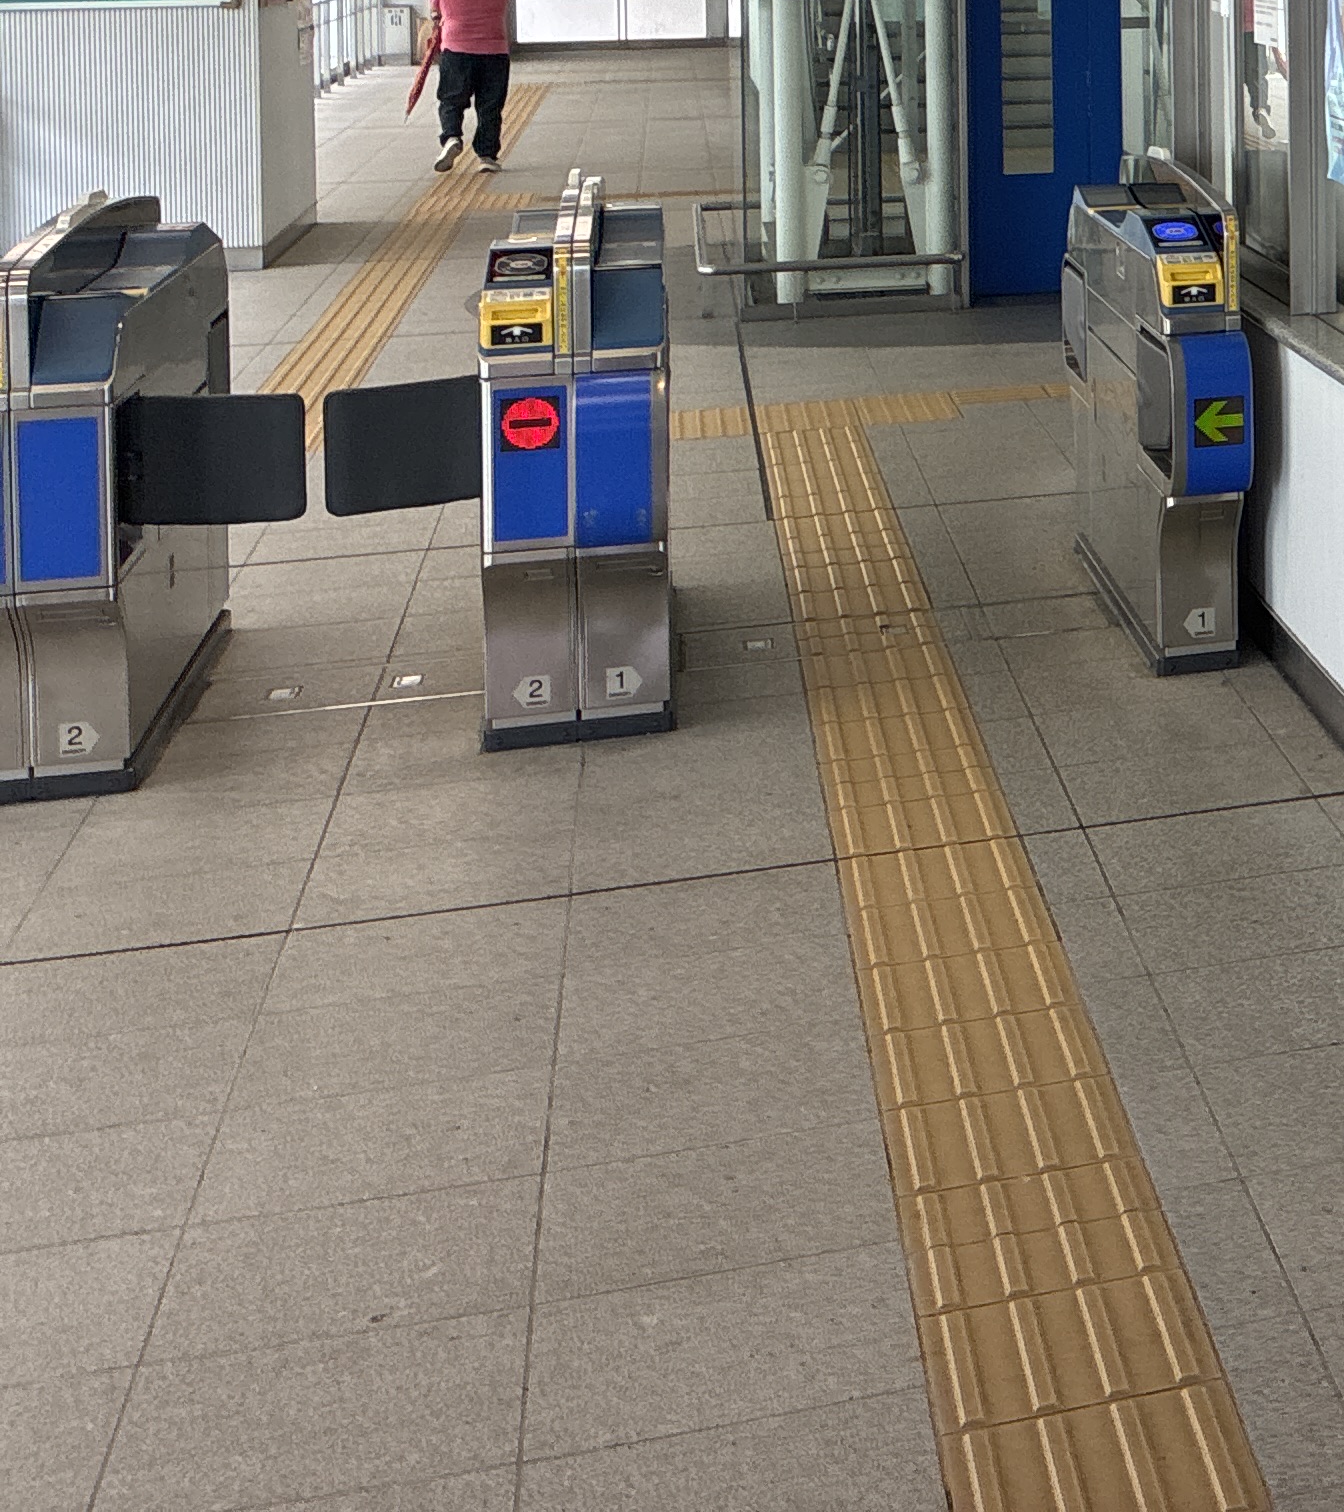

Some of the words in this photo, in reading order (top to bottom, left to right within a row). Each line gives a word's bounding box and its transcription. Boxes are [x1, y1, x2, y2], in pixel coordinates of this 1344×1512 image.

[1197, 611, 1208, 628] 1
[614, 671, 625, 688] 1
[529, 679, 544, 699] 2
[67, 726, 84, 745] 2
